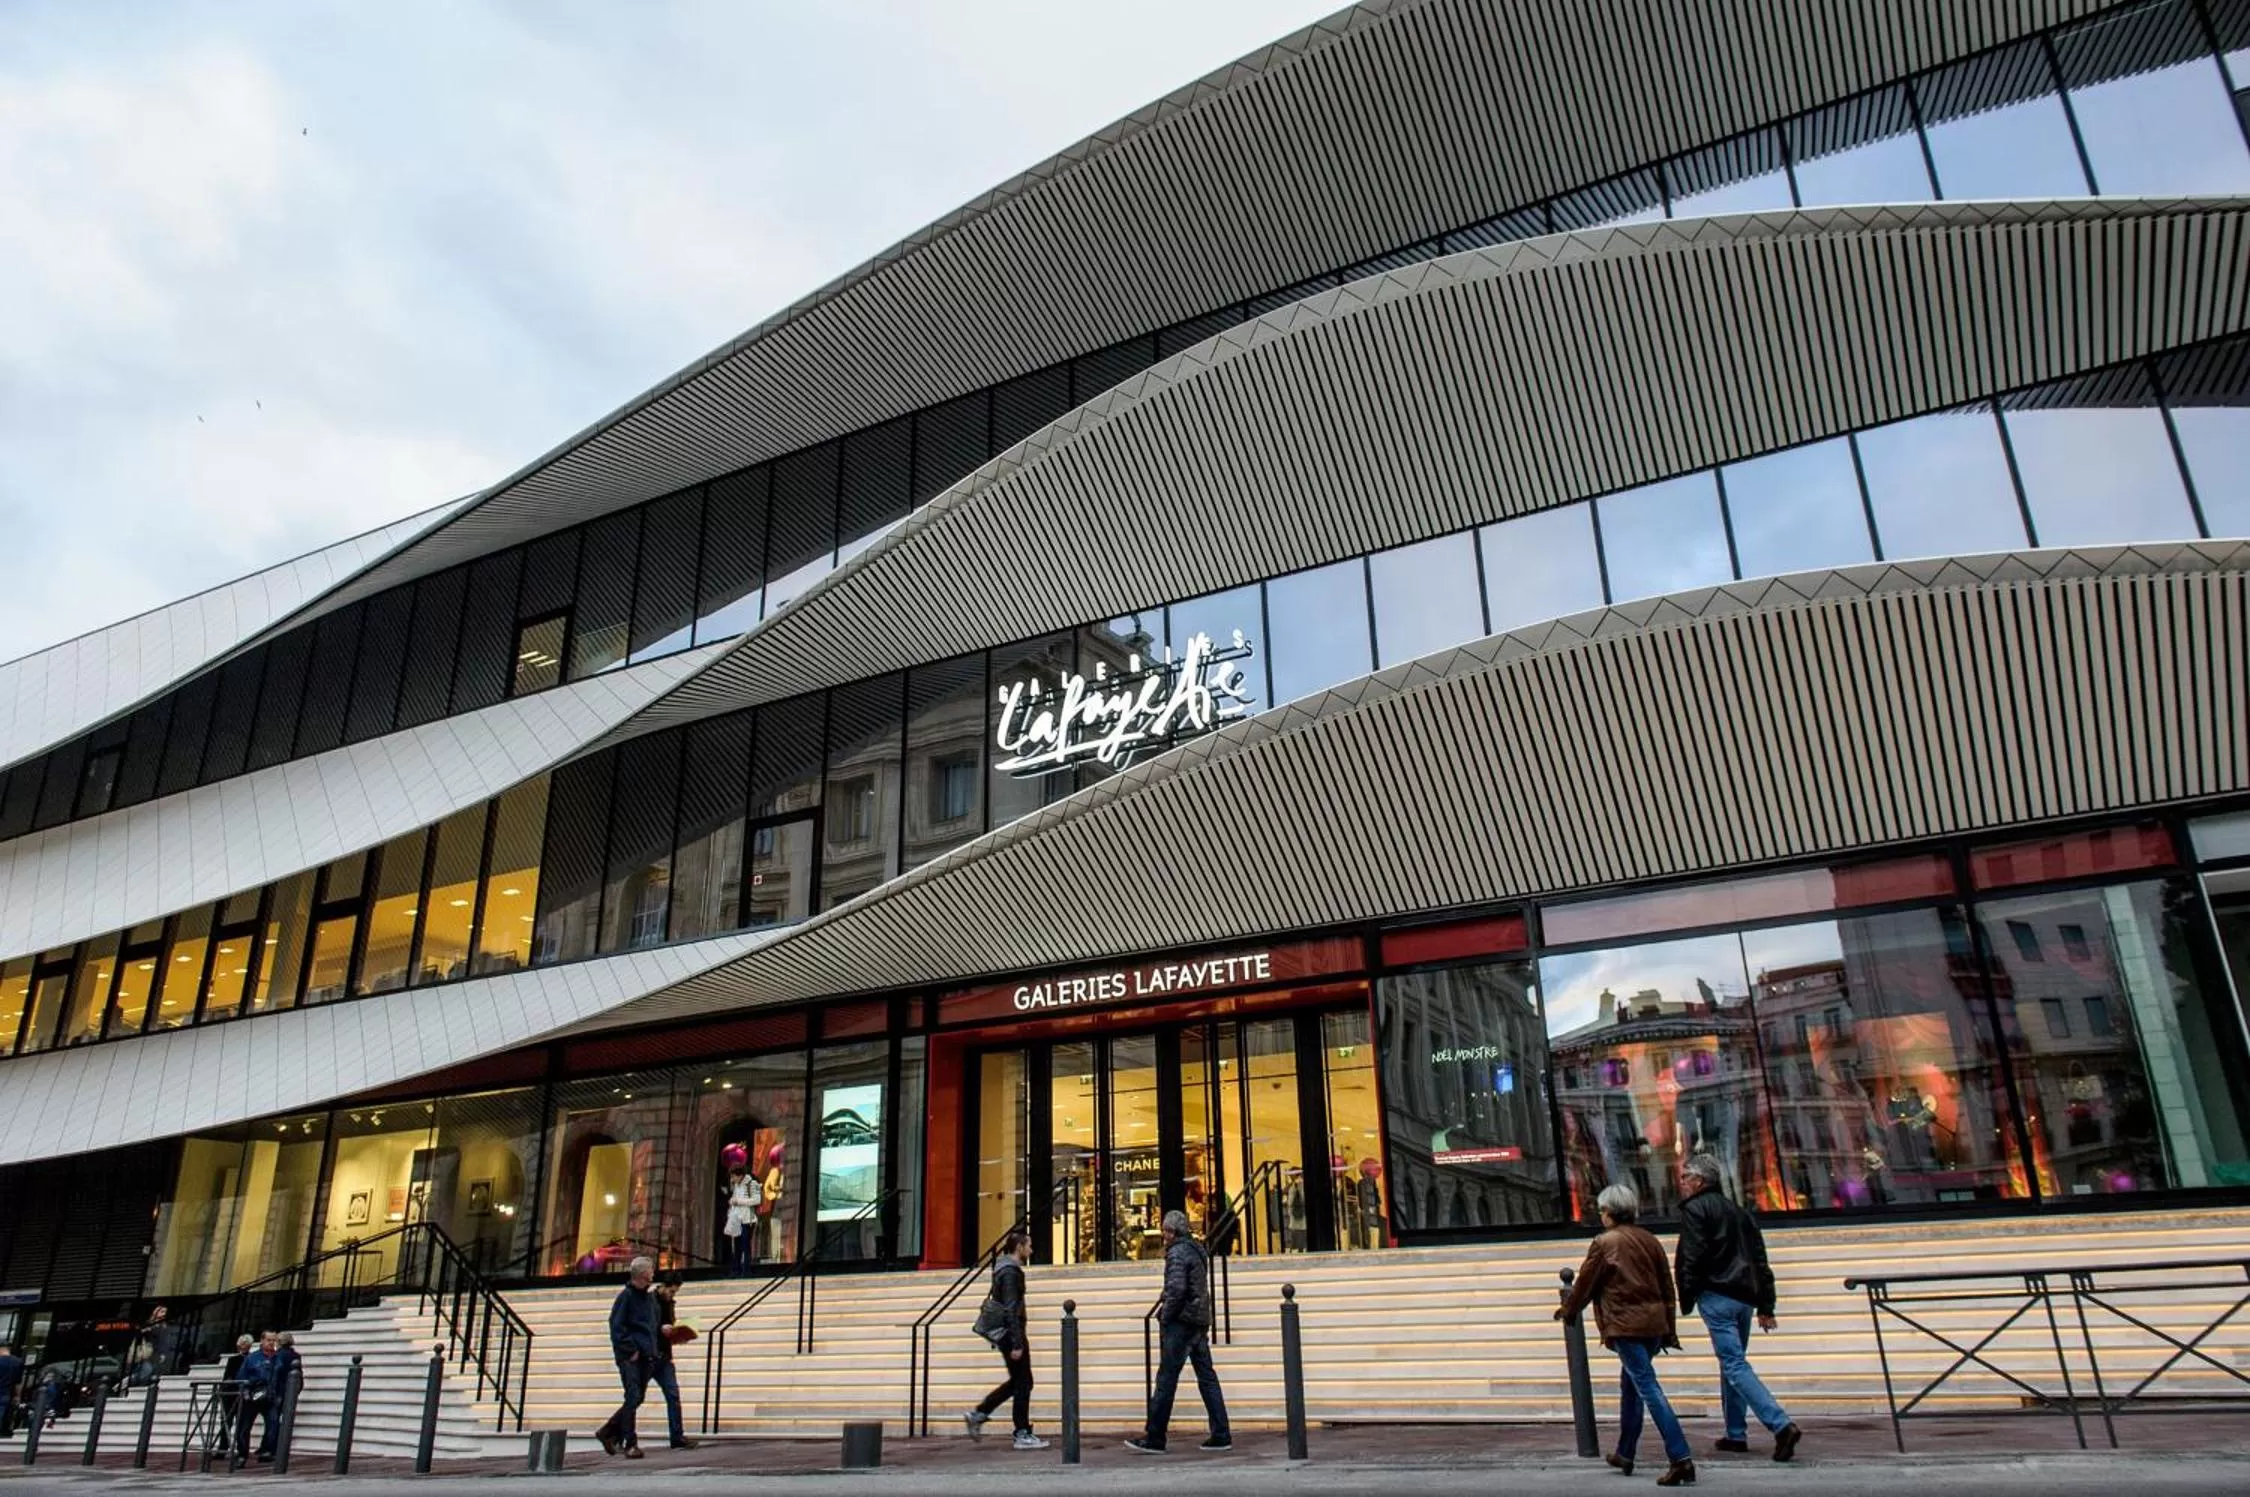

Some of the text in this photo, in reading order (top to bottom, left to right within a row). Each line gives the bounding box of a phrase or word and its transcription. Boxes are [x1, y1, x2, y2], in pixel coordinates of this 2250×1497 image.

[1013, 954, 1270, 1010] GALERIES LAFAYETTE
[1114, 1157, 1160, 1173] CHANE
